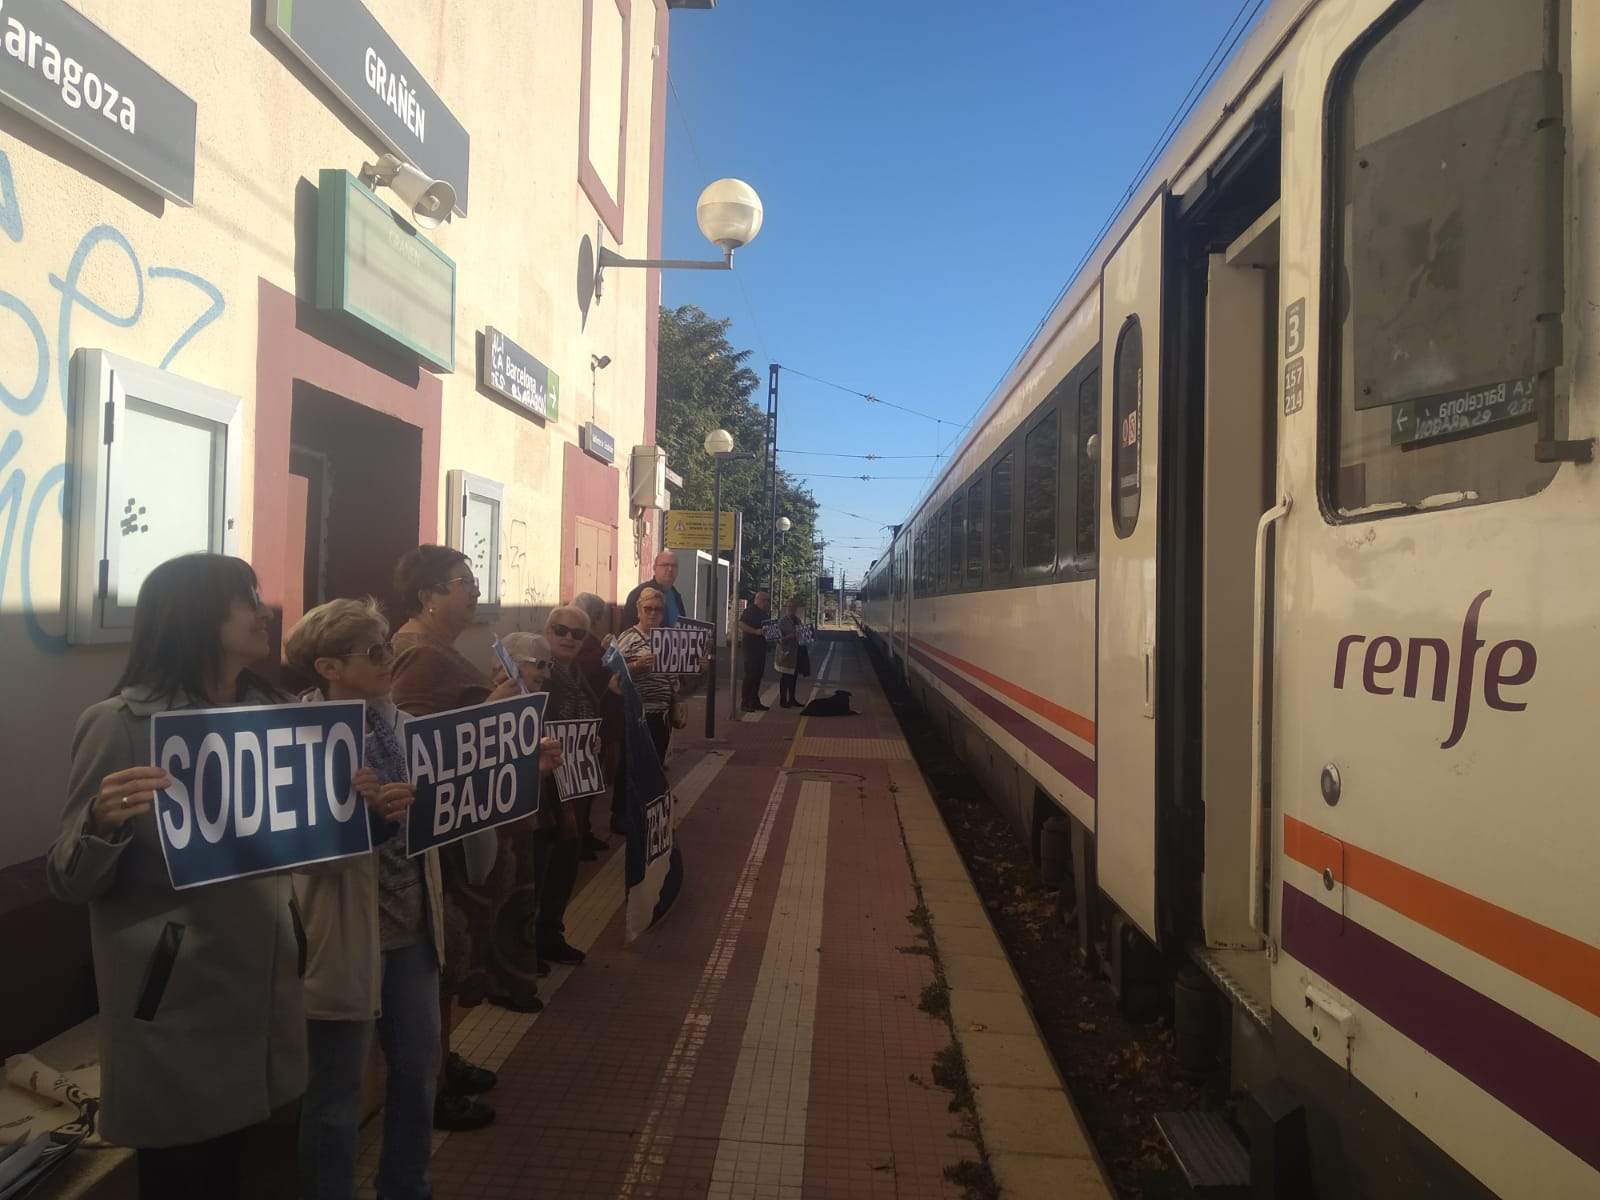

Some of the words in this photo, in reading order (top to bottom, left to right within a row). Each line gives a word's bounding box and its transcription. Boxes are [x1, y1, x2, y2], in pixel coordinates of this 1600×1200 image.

[0, 0, 136, 134] aragoza
[364, 46, 426, 144] GRAÑÉN
[1287, 313, 1301, 353] 3
[505, 354, 538, 393] Barcelona
[1285, 366, 1303, 390] 157
[652, 629, 704, 673] ROBRES
[1333, 588, 1538, 750] renfe
[411, 705, 540, 785] ALBERO
[160, 721, 359, 851] SODETO
[432, 763, 517, 836] BAJO
